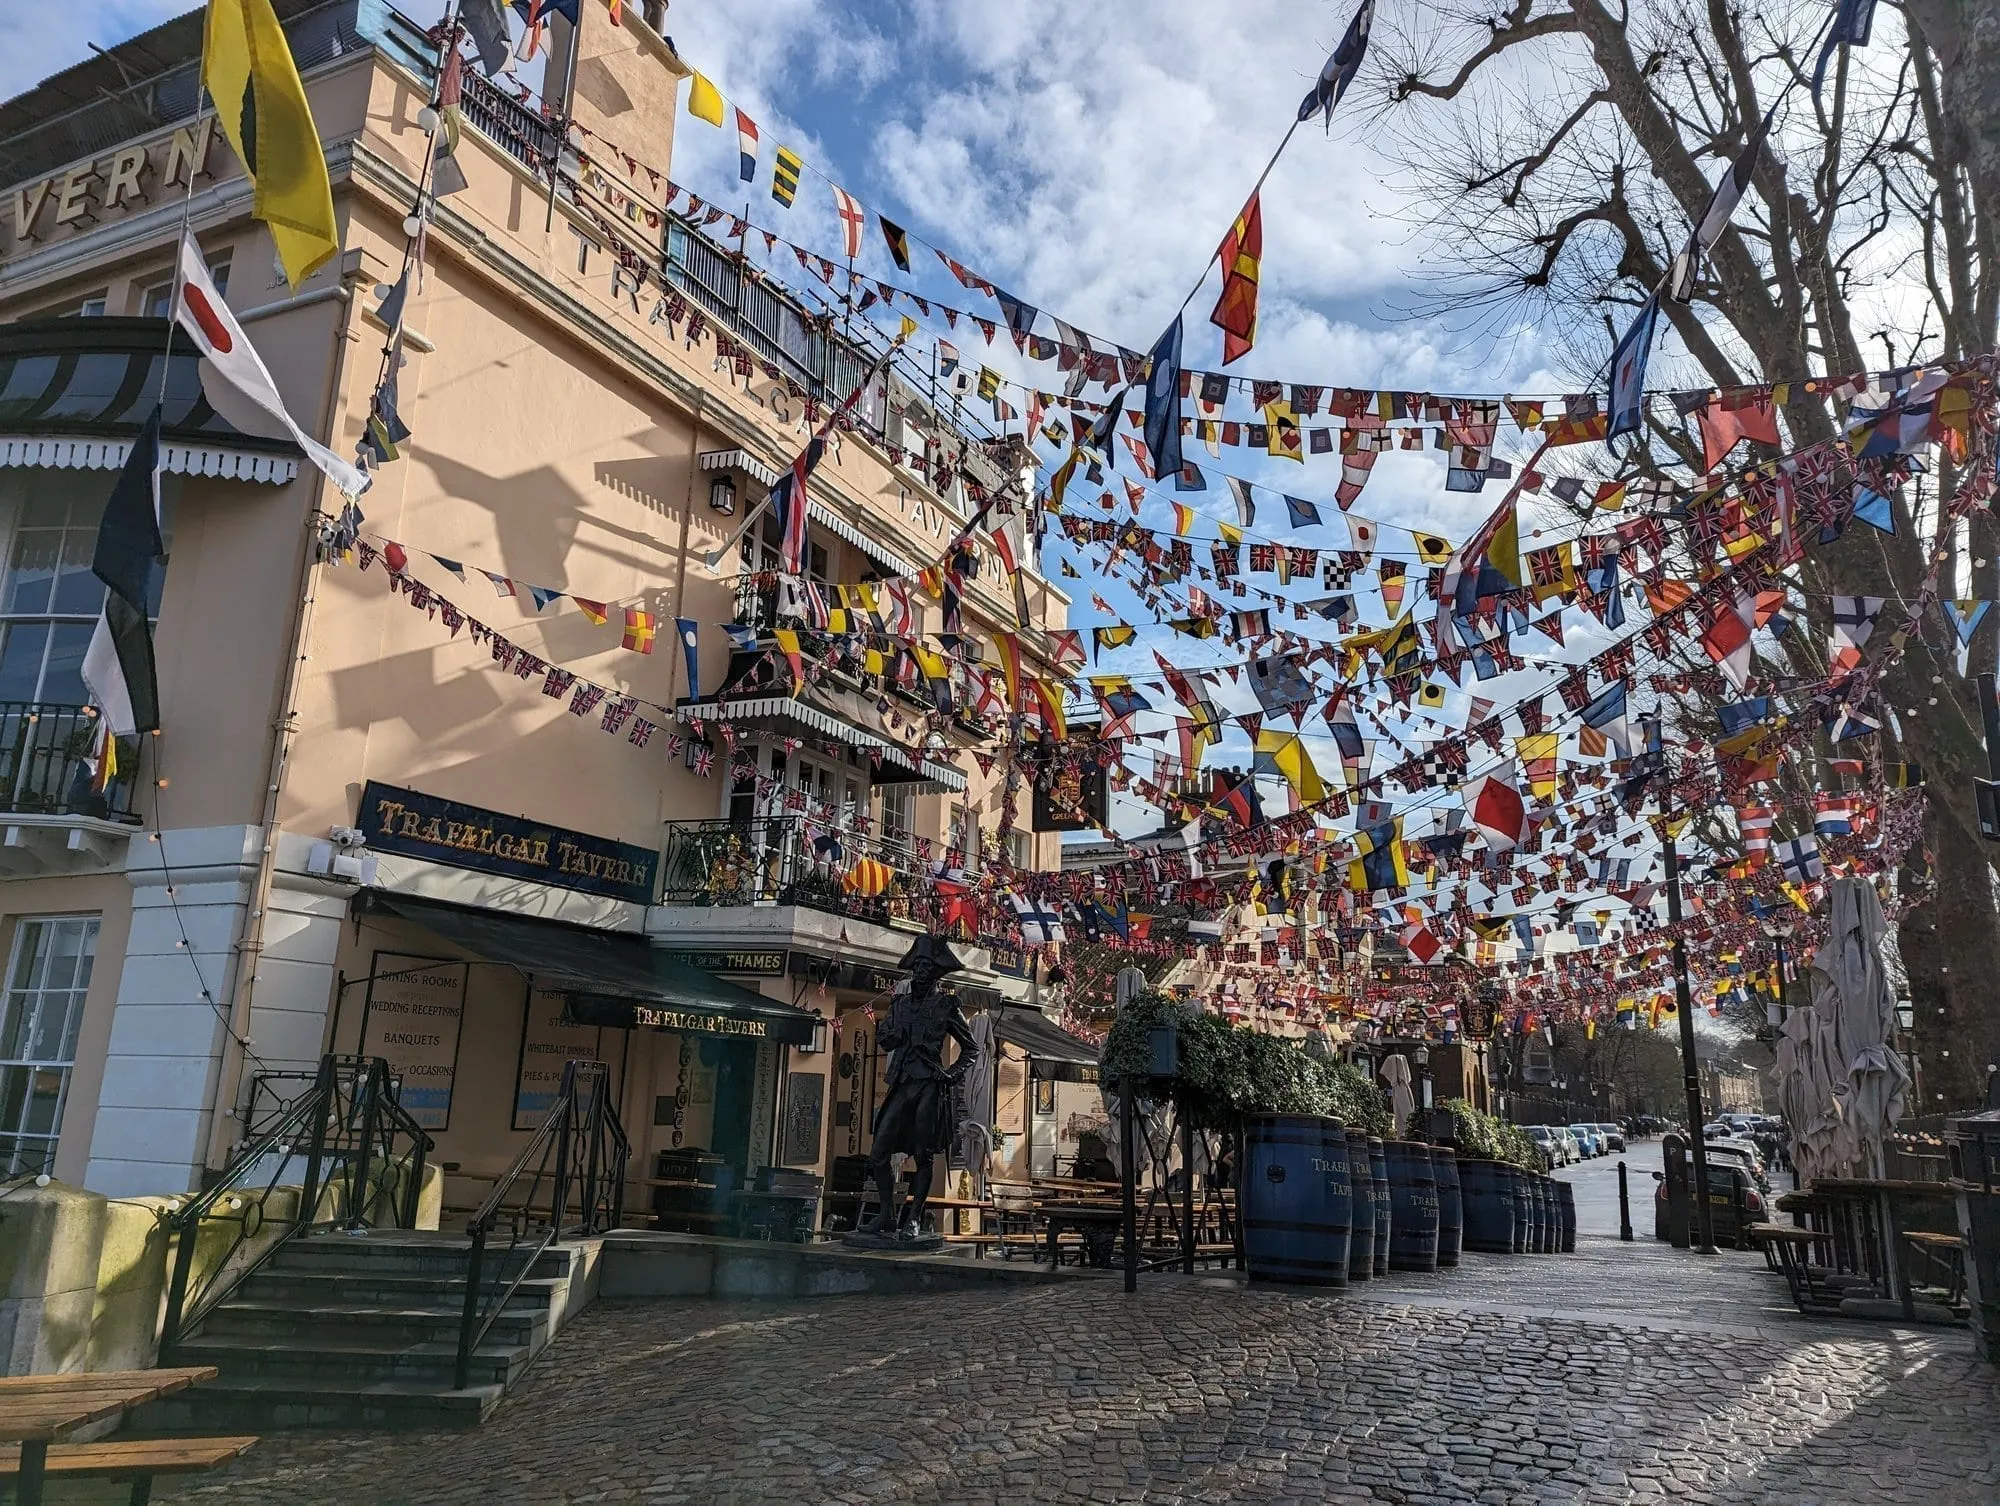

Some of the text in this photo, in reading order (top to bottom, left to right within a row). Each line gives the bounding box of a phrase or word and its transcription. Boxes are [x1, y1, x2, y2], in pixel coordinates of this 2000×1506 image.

[15, 117, 216, 242] VERN
[377, 799, 649, 888] TRAFALGAR TAVERN
[727, 954, 781, 969] THAMES
[380, 970, 458, 988] DINING ROOMS
[370, 1000, 460, 1017] WEDDING RECEPTIONS
[633, 1005, 767, 1037] TRAFALGAR TAVERN
[384, 1032, 440, 1046] BANQUETS
[527, 1043, 566, 1055] WHITEBAIT
[409, 1064, 454, 1076] OCCASIONS
[524, 1071, 543, 1081] PIES
[544, 1072, 550, 1081] &
